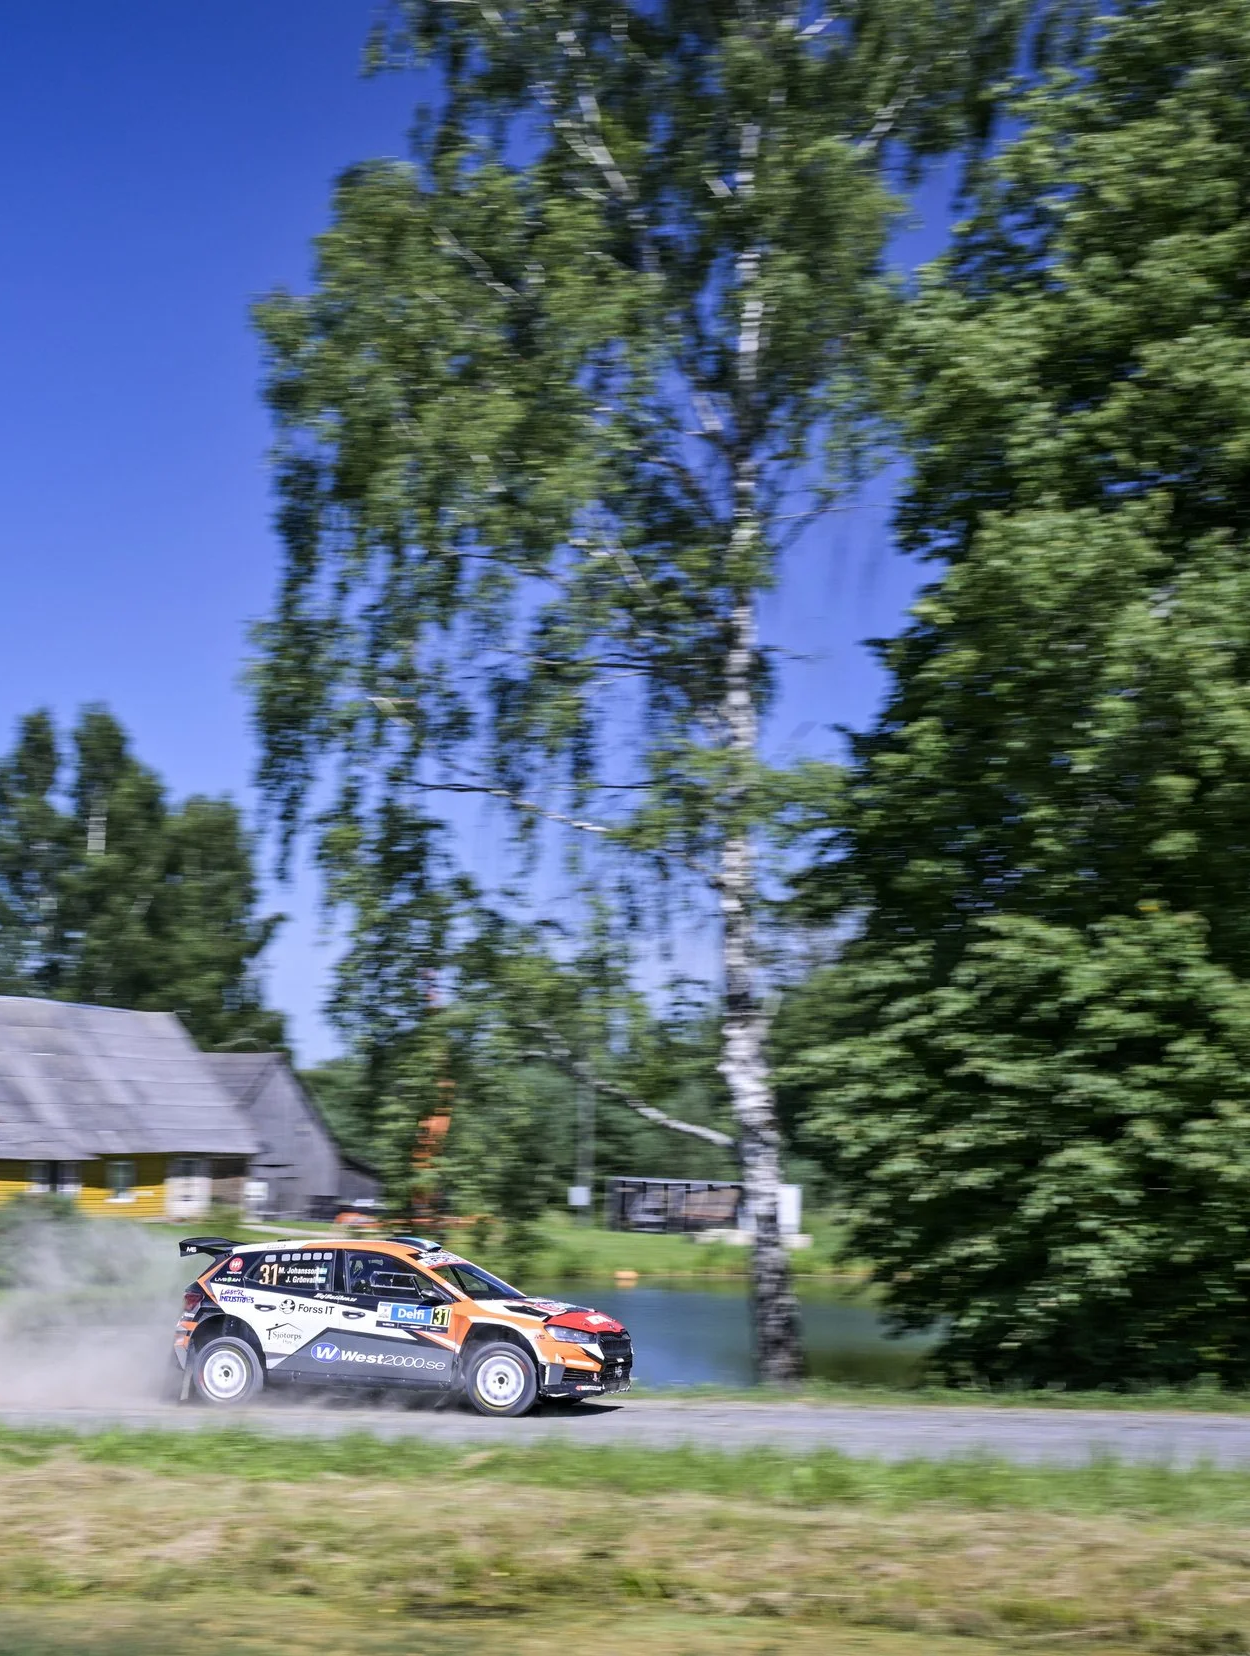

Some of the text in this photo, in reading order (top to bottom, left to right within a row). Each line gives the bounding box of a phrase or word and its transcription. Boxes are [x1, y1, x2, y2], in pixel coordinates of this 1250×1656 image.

[258, 1263, 279, 1285] 31
[278, 1266, 319, 1275] M. Johansson
[285, 1275, 291, 1283] J.
[298, 1303, 335, 1315] Forss IT
[397, 1308, 425, 1320] Delfi
[433, 1308, 449, 1326] 31
[340, 1349, 446, 1371] West2000.se
